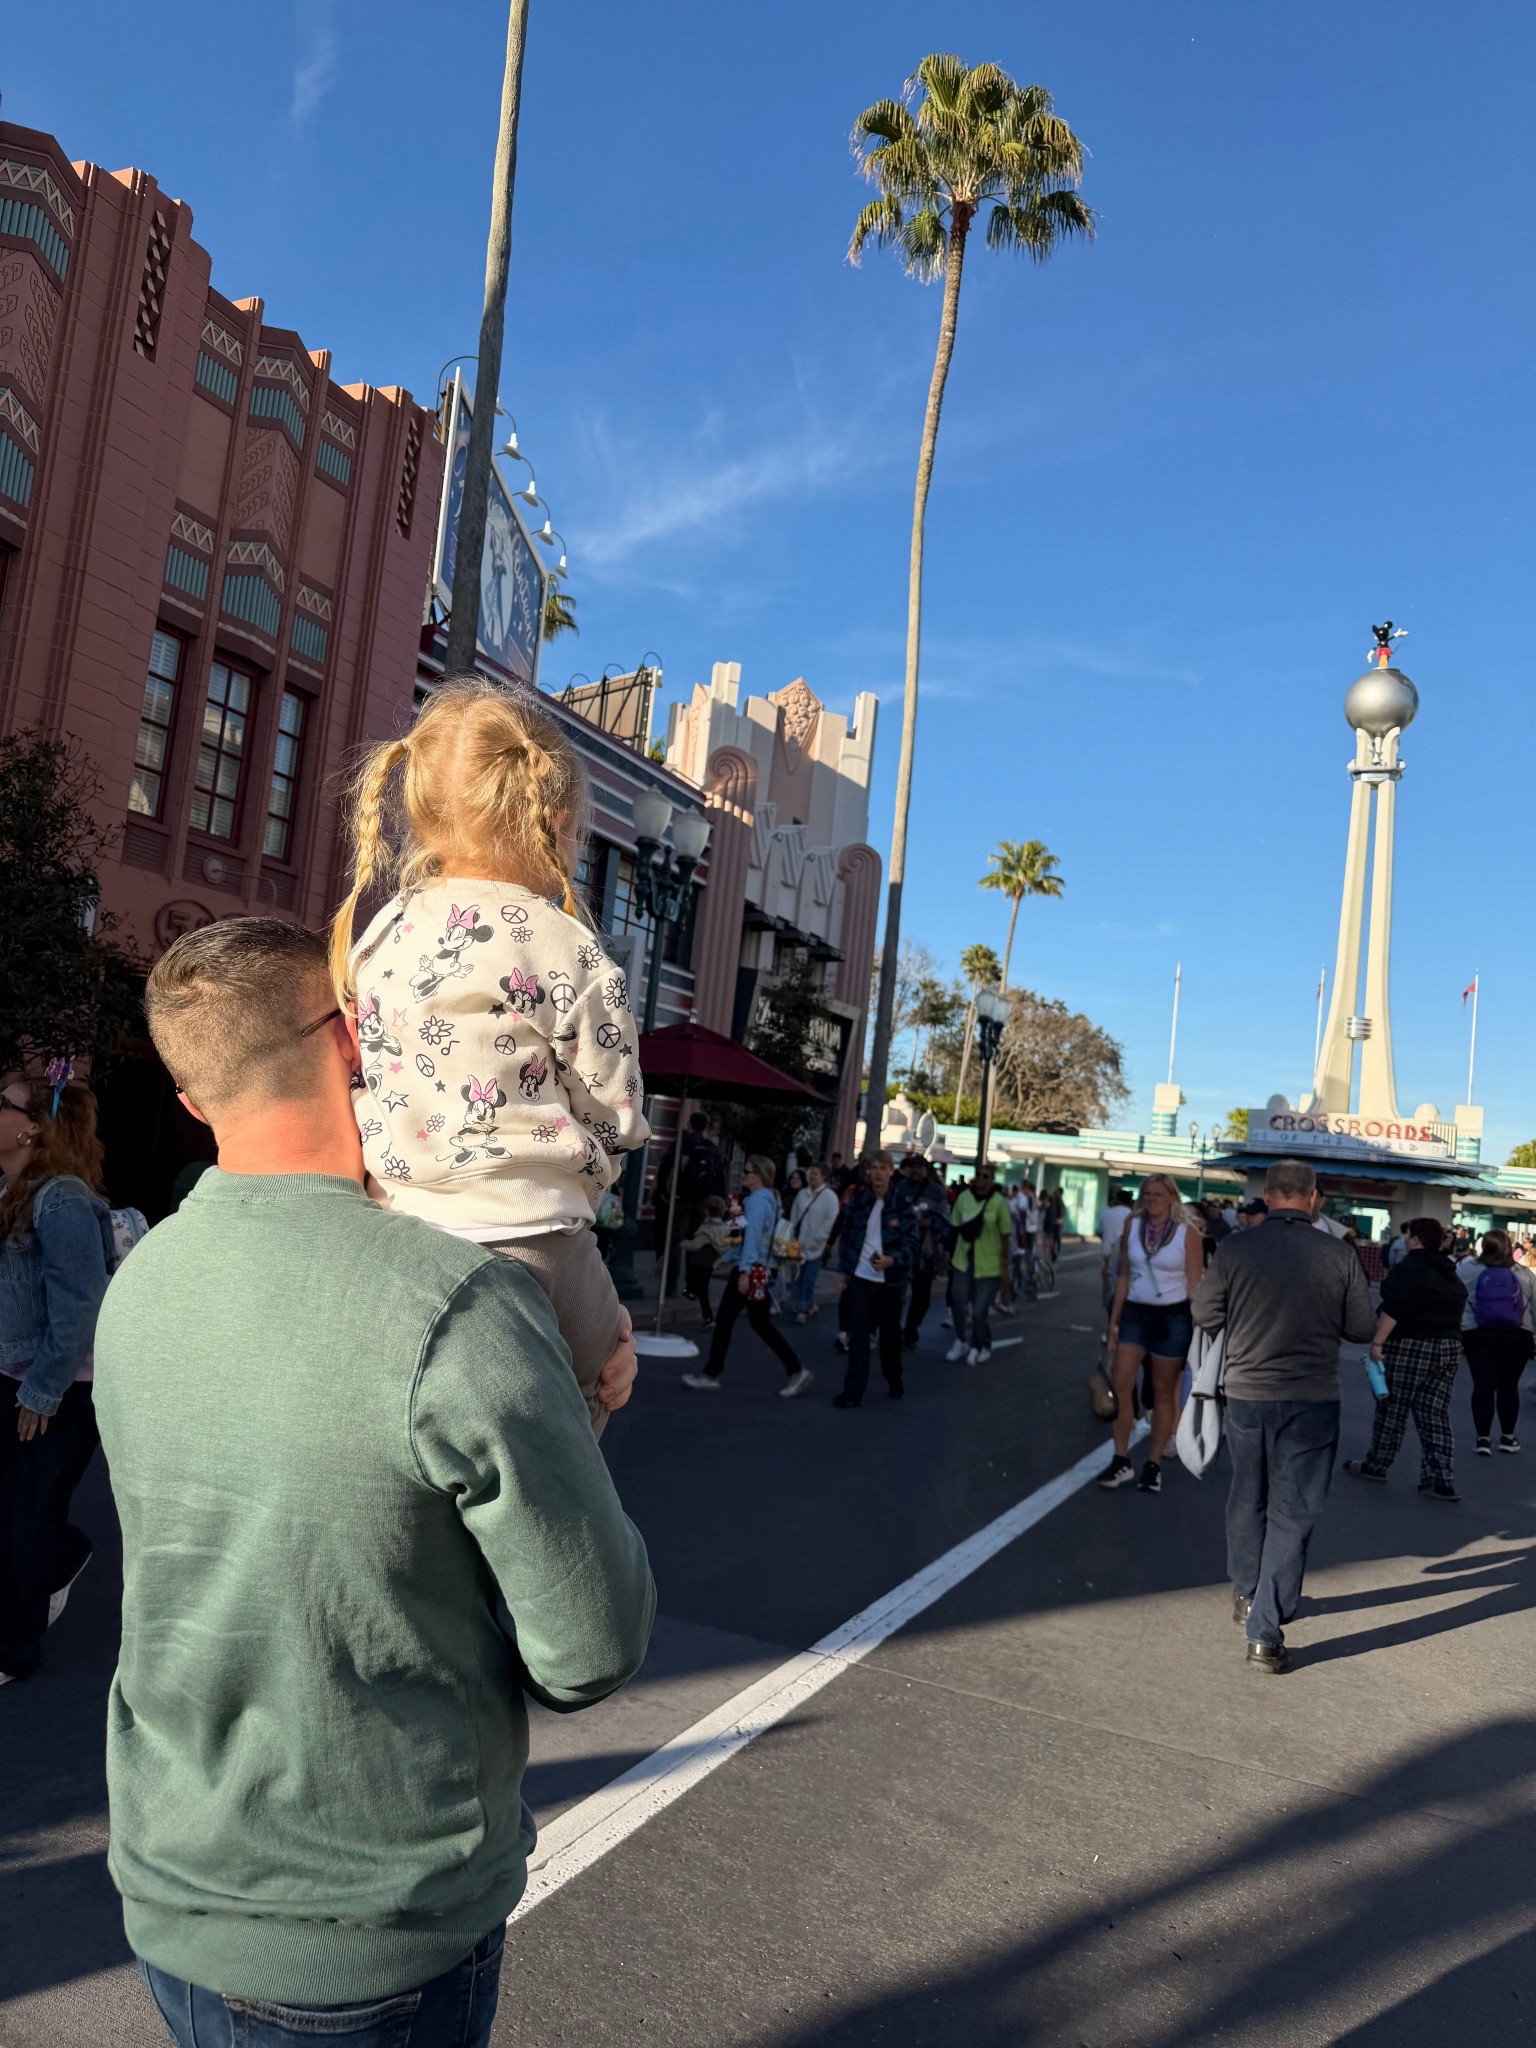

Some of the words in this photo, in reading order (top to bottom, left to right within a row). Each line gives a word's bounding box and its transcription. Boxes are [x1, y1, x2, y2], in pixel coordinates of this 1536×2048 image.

[1269, 1114, 1432, 1142] CROSSROADS
[1280, 1133, 1298, 1142] OF
[1311, 1135, 1343, 1145] THE
[1356, 1139, 1418, 1151] WORLD
